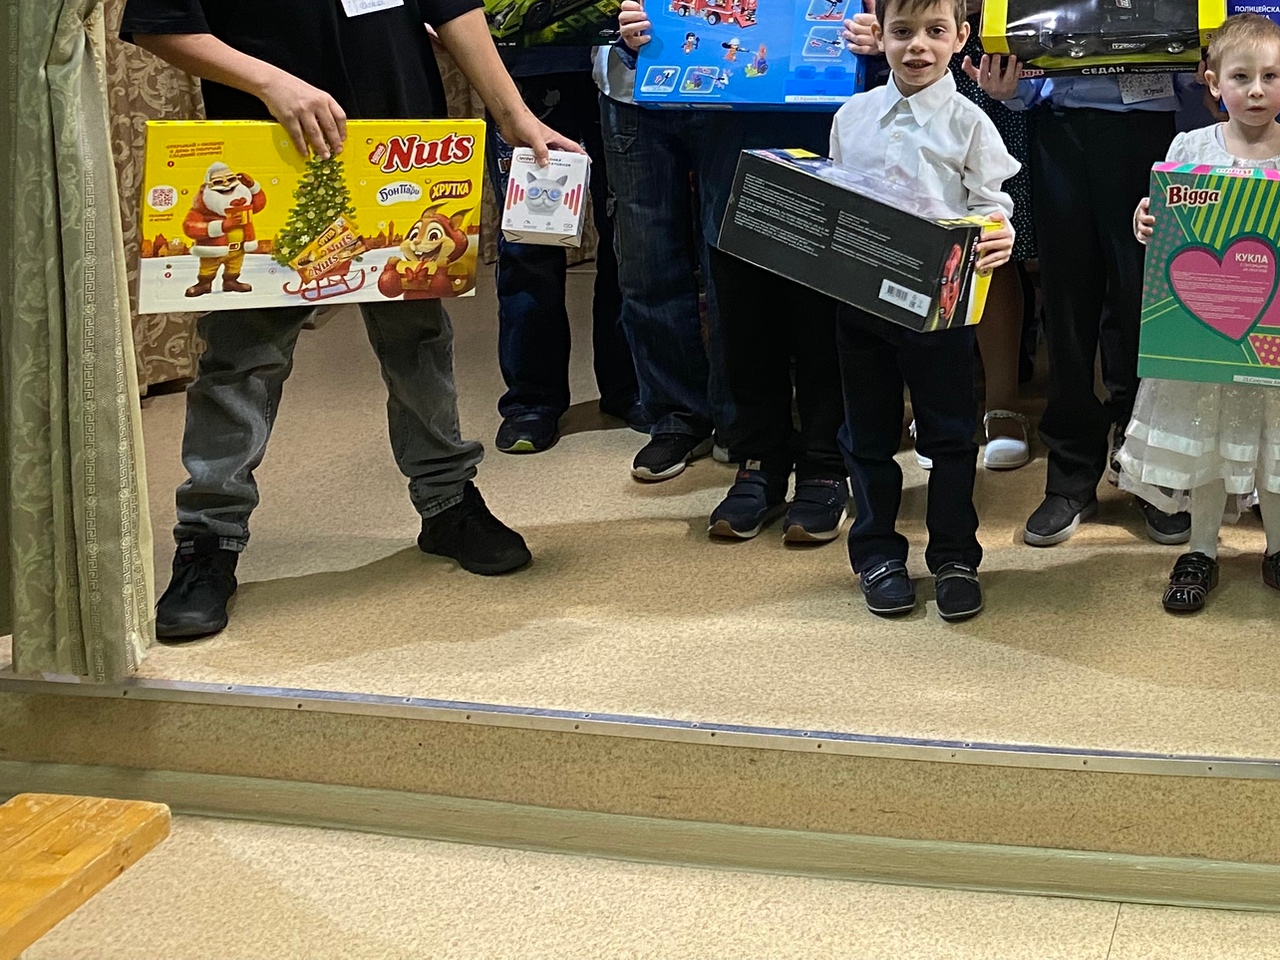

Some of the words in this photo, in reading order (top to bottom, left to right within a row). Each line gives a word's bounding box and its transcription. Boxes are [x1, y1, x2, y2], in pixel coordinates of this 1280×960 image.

[1081, 66, 1125, 75] СЕДАН
[382, 134, 474, 172] Nuts
[431, 181, 470, 199] ХРУТКА
[1168, 186, 1219, 205] Bigga
[313, 252, 339, 275] Nuts
[1235, 252, 1268, 264] КУКЛА
